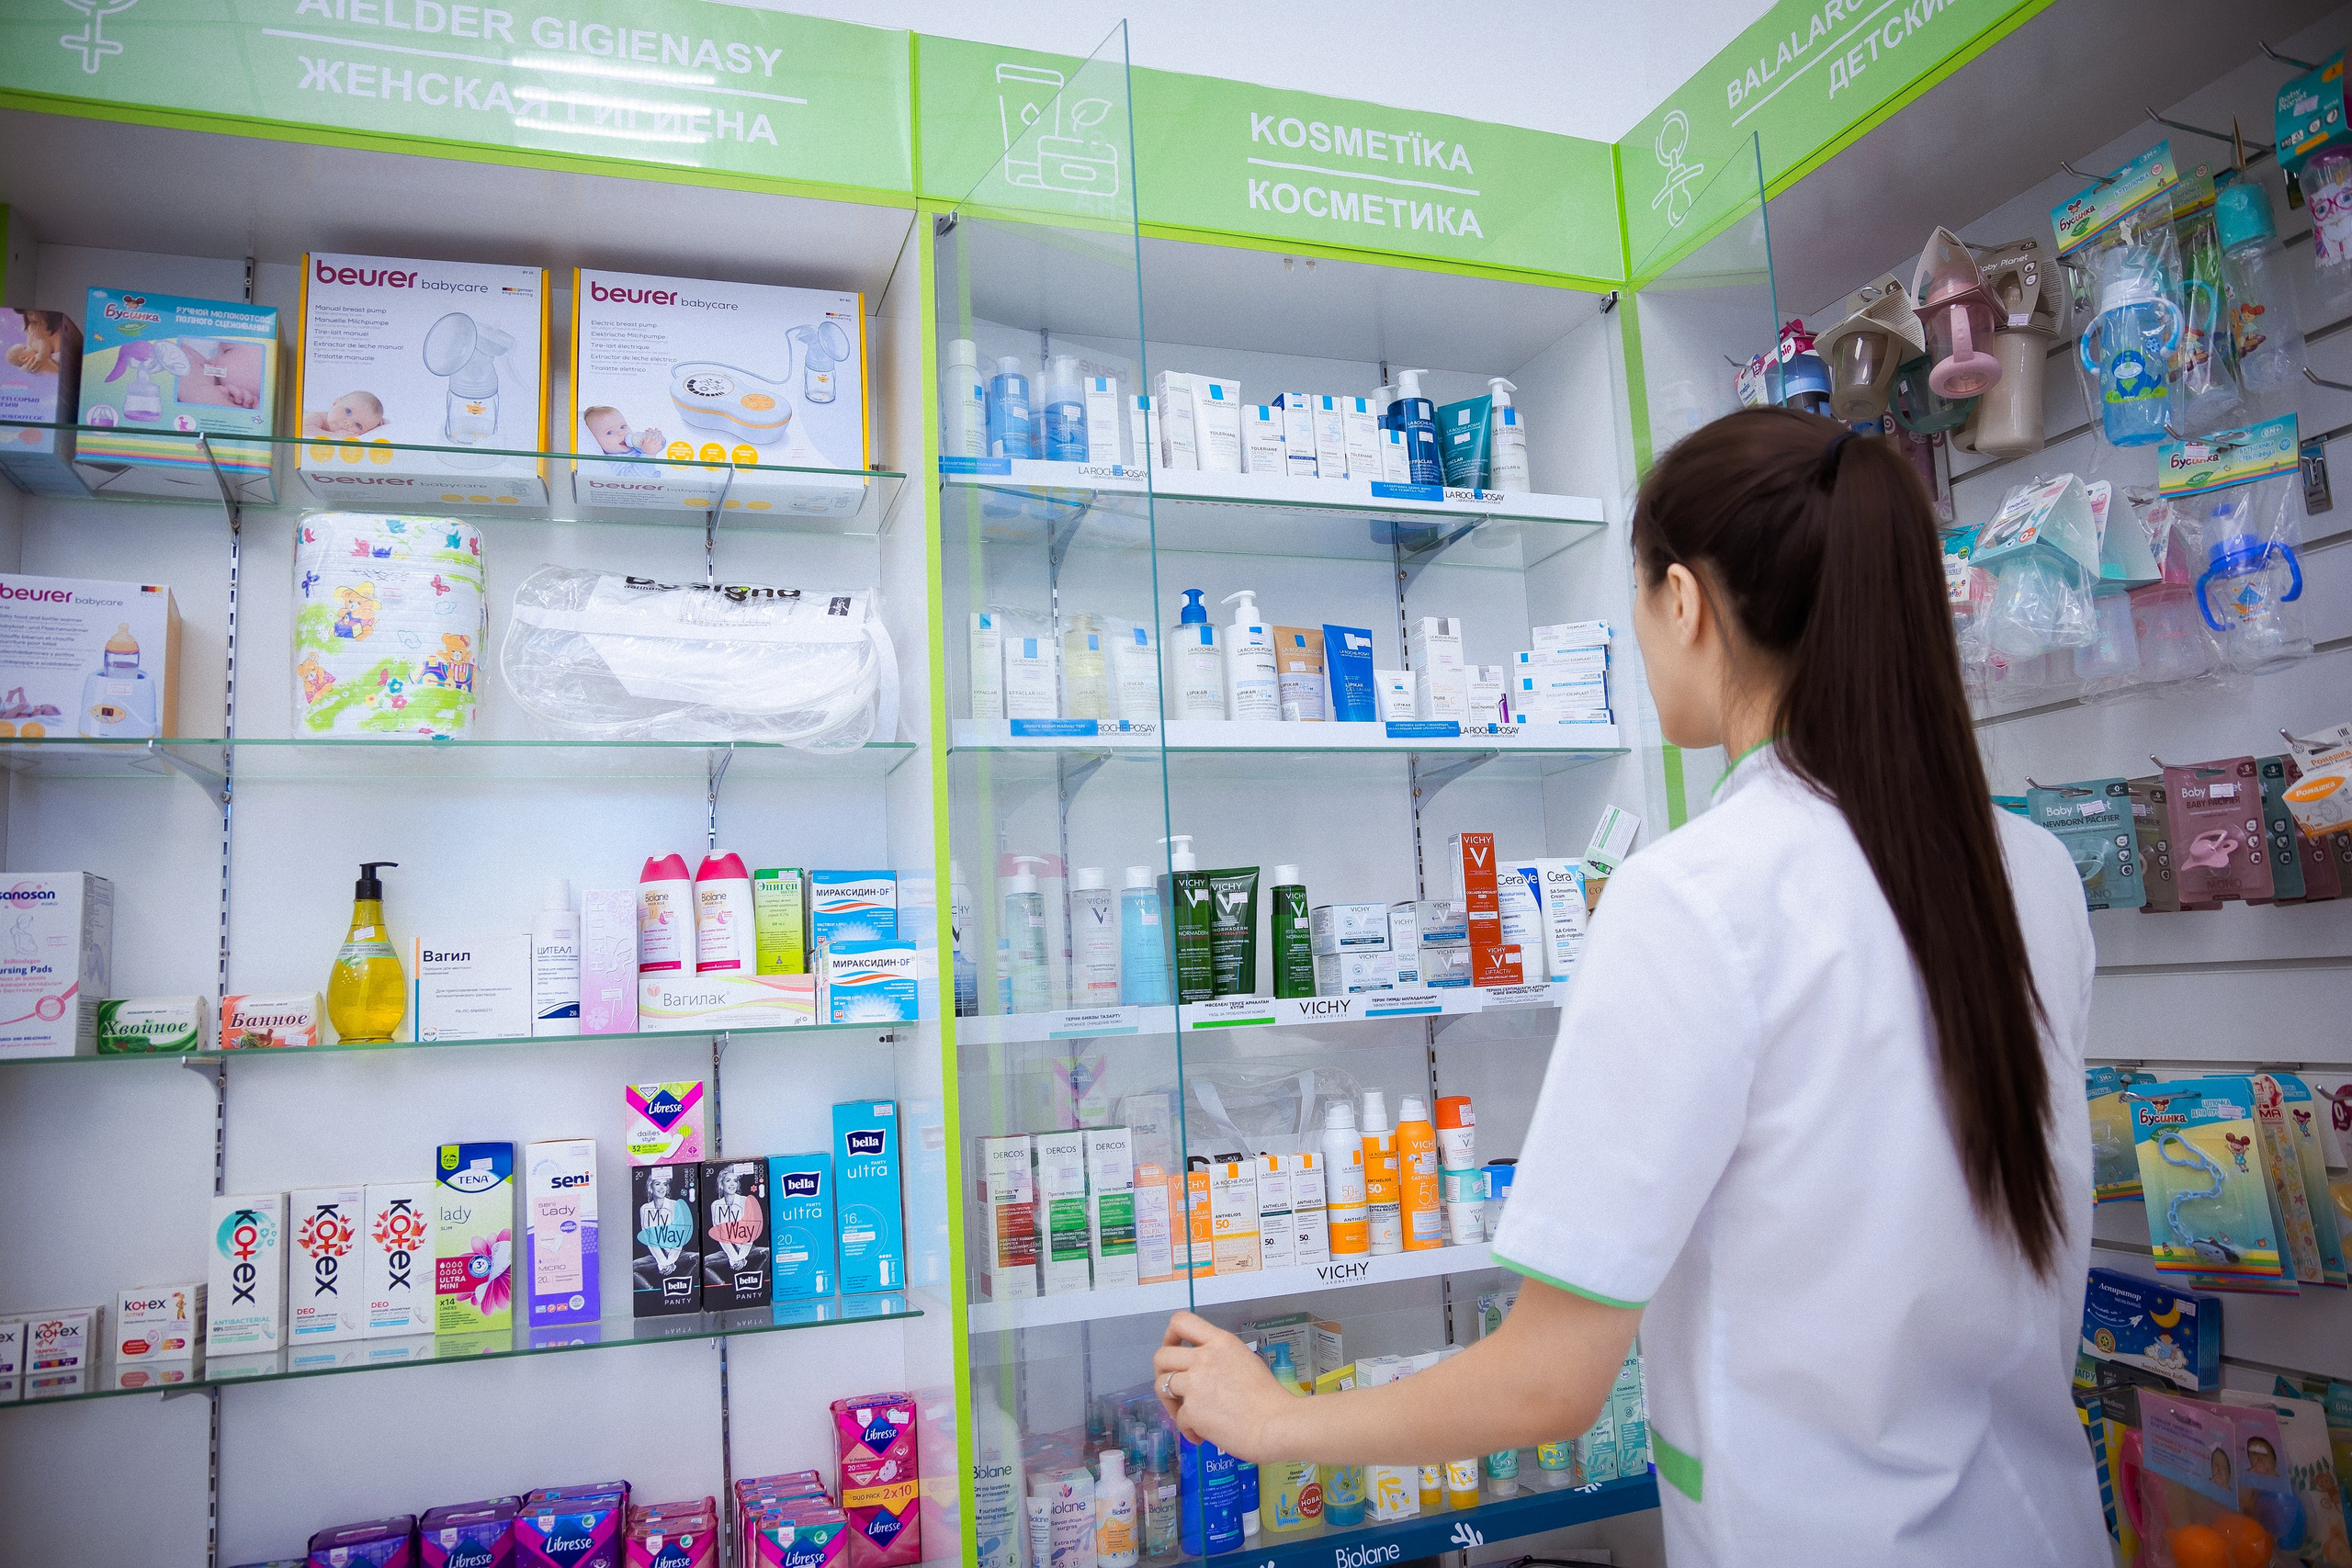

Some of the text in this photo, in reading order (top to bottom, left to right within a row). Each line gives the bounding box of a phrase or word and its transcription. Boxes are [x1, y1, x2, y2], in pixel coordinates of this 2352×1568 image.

[530, 16, 783, 77] GIGIENASY
[1829, 0, 1956, 100] ДЕТСКИ
[297, 56, 549, 118] ЖЕНСКАЯ
[1250, 111, 1474, 175] KOSMETÏKA
[1248, 178, 1484, 239] КОСМЕТИКА
[2059, 205, 2096, 231] Бусинка
[2001, 254, 2029, 267] Planet
[316, 260, 488, 293] beurer babycare
[591, 281, 739, 311] beurer babycare
[105, 302, 161, 322] Бусинка
[1091, 468, 1120, 476] ROCHE
[1122, 468, 1148, 478] POSAY
[1456, 491, 1480, 500] ROCHE
[1482, 493, 1504, 502] POSAY
[0, 583, 123, 606] beurer babycare
[1098, 724, 1127, 732] ROCHE
[2182, 786, 2205, 798] Baby
[2296, 781, 2335, 796] РОМАШКА
[2187, 796, 2240, 809] BABY PACIFIER
[2046, 806, 2071, 817] Baby
[2043, 813, 2120, 828] NEWBORN PACIFIER
[1464, 836, 1492, 844] VICHY
[1498, 874, 1538, 885] CeraVe
[1547, 871, 1583, 883] CeraVe
[756, 881, 797, 892] Эпиген
[816, 887, 889, 897] МИРАКСИДИН-DF
[1212, 882, 1242, 891] VICHY
[645, 893, 669, 902] Biolane
[701, 892, 727, 902] Biolane
[423, 950, 470, 963] Вагил
[537, 946, 571, 955] ЦИТЕАЛ
[832, 958, 910, 968] МИРАКСИДИН-DF
[663, 993, 726, 1007] Вагилак
[1299, 999, 1351, 1015] VICHY
[229, 1012, 309, 1029] Банное
[102, 1019, 187, 1037] Хвойное
[648, 1101, 684, 1114] Libresse
[2140, 1109, 2187, 1126] Бусинка
[853, 1136, 879, 1147] bella
[1096, 1142, 1125, 1150] DERCOS
[632, 1145, 641, 1153] 32
[993, 1151, 1023, 1159] DERCOS
[1046, 1145, 1077, 1154] DERCOS
[847, 1165, 888, 1179] ultra
[458, 1176, 489, 1184] TENA
[551, 1171, 590, 1189] seni
[787, 1179, 815, 1190] bella
[440, 1205, 471, 1224] lady
[648, 1209, 669, 1231] My
[719, 1206, 740, 1226] My
[783, 1206, 822, 1221] ultra
[843, 1213, 857, 1224] 16
[654, 1224, 684, 1247] Way
[726, 1221, 755, 1244] Way
[777, 1235, 793, 1245] 20
[1317, 1262, 1369, 1280] VICHY
[439, 1275, 466, 1283] ULTRA
[668, 1280, 687, 1290] bella
[740, 1276, 758, 1285] bella
[1322, 1276, 1366, 1285] LABORATOIRES
[2098, 1281, 2142, 1301] Аспиратор
[125, 1299, 166, 1312] kotex
[439, 1298, 455, 1306] x14
[213, 1316, 270, 1326] ANTIBACTERIAL
[865, 1427, 897, 1441] Libresse
[1206, 1458, 1235, 1472] Biolane
[883, 1485, 912, 1499] 2x10
[1112, 1506, 1131, 1515] Biolane
[1148, 1504, 1176, 1514] Biolane
[868, 1520, 900, 1534] Libresse
[546, 1537, 594, 1554] Libresse
[448, 1553, 493, 1568] Libresse
[655, 1551, 691, 1568] Libresse
[786, 1551, 825, 1566] Libresse
[1335, 1543, 1400, 1568] Biolane
